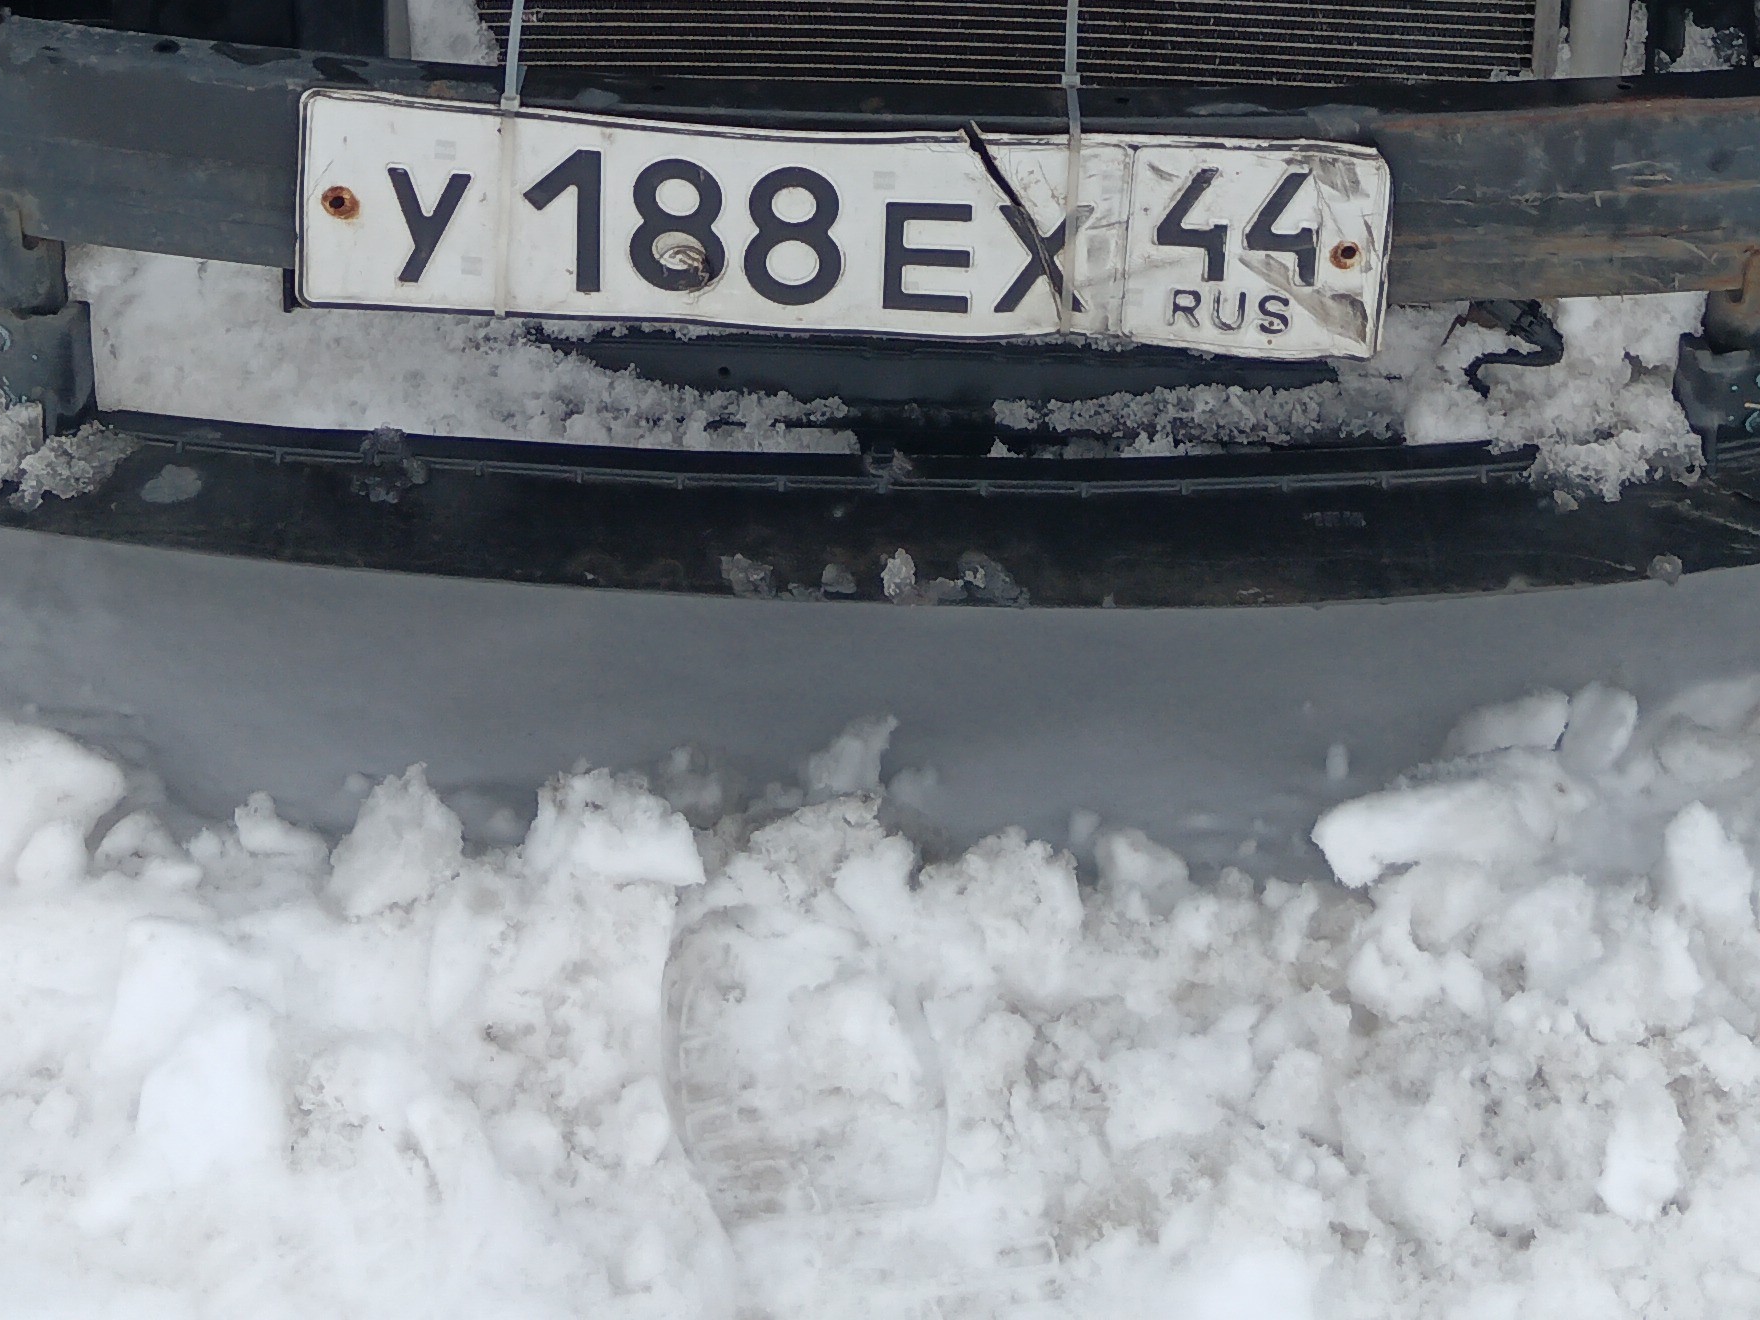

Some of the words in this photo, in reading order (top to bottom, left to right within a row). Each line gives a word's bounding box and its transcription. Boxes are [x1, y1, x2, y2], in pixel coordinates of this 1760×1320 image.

[521, 148, 843, 307] 188
[1156, 165, 1320, 288] 44
[1171, 288, 1291, 335] RUS
